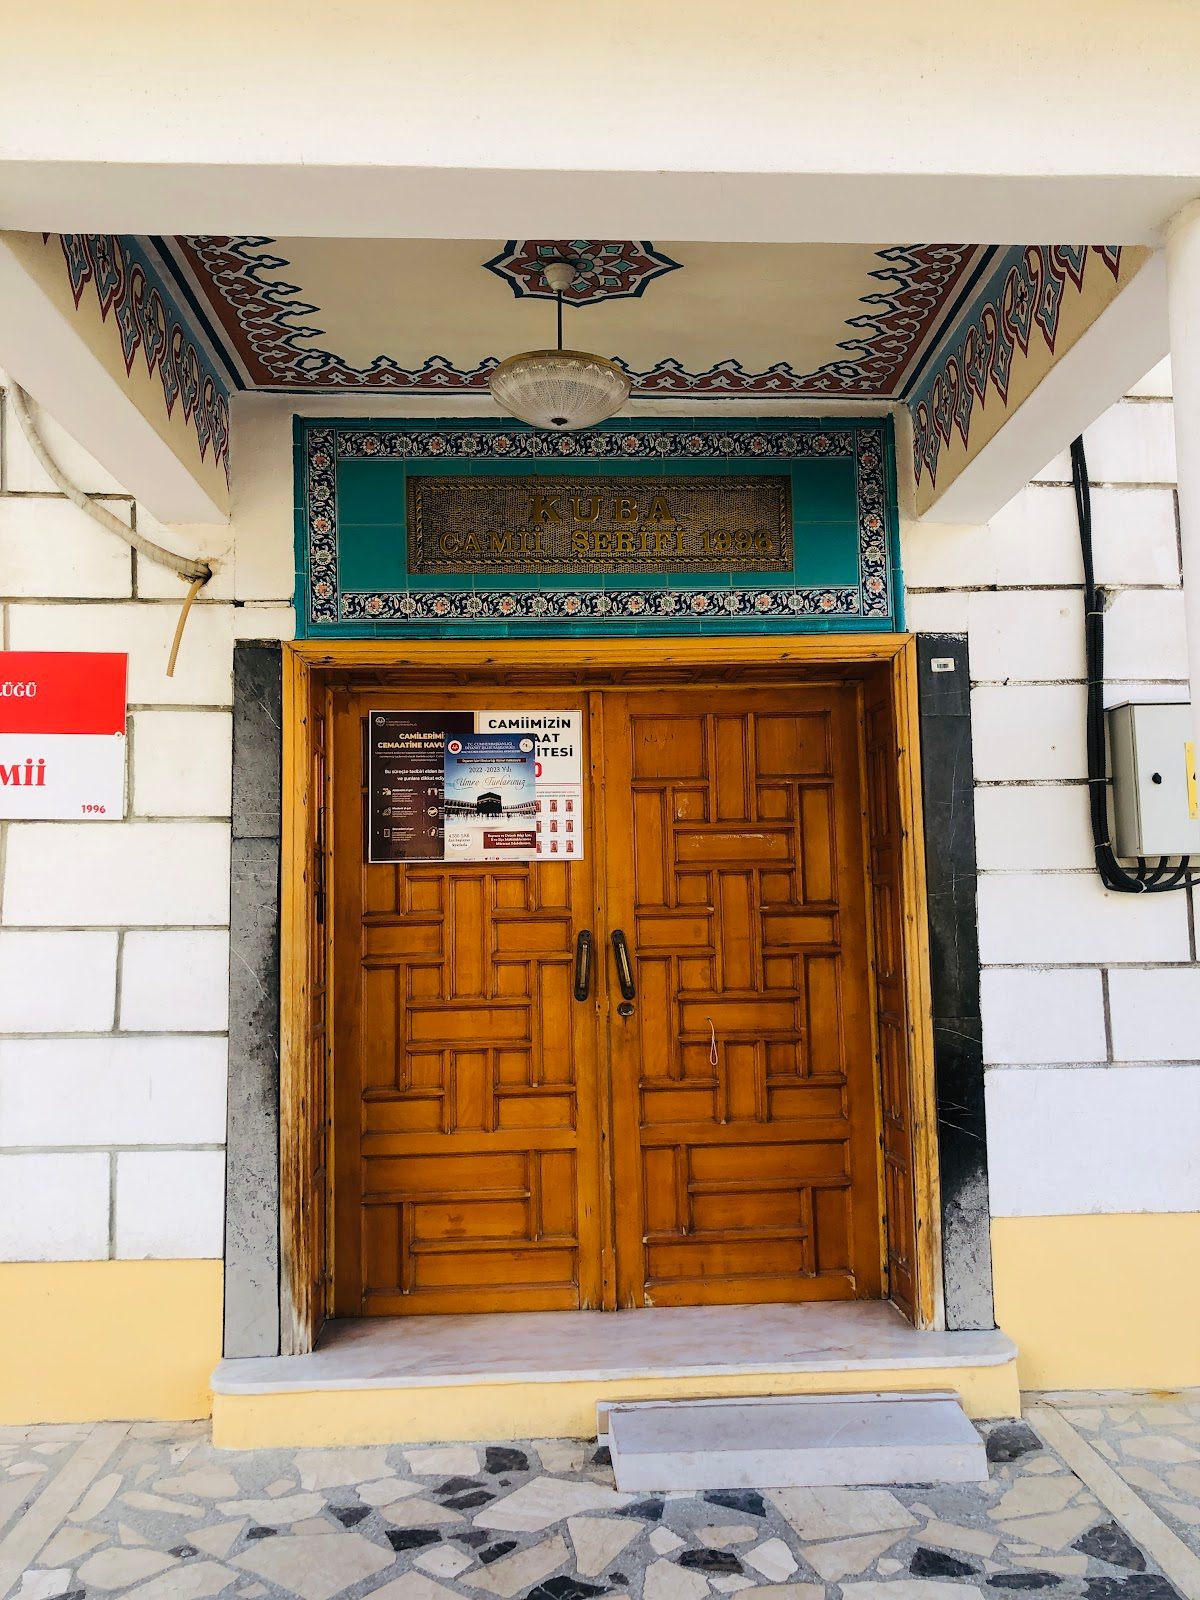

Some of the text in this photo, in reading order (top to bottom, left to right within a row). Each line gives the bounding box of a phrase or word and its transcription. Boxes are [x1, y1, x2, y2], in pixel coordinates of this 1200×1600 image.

[530, 496, 677, 524] KUBA
[440, 526, 544, 554] CAMİİ
[701, 529, 774, 552] 1996
[489, 716, 571, 729] CAMİİMİZİN
[399, 731, 445, 740] CAMİLERİMİ
[377, 740, 422, 749] CEMAATİNE
[81, 804, 106, 814] 1996
